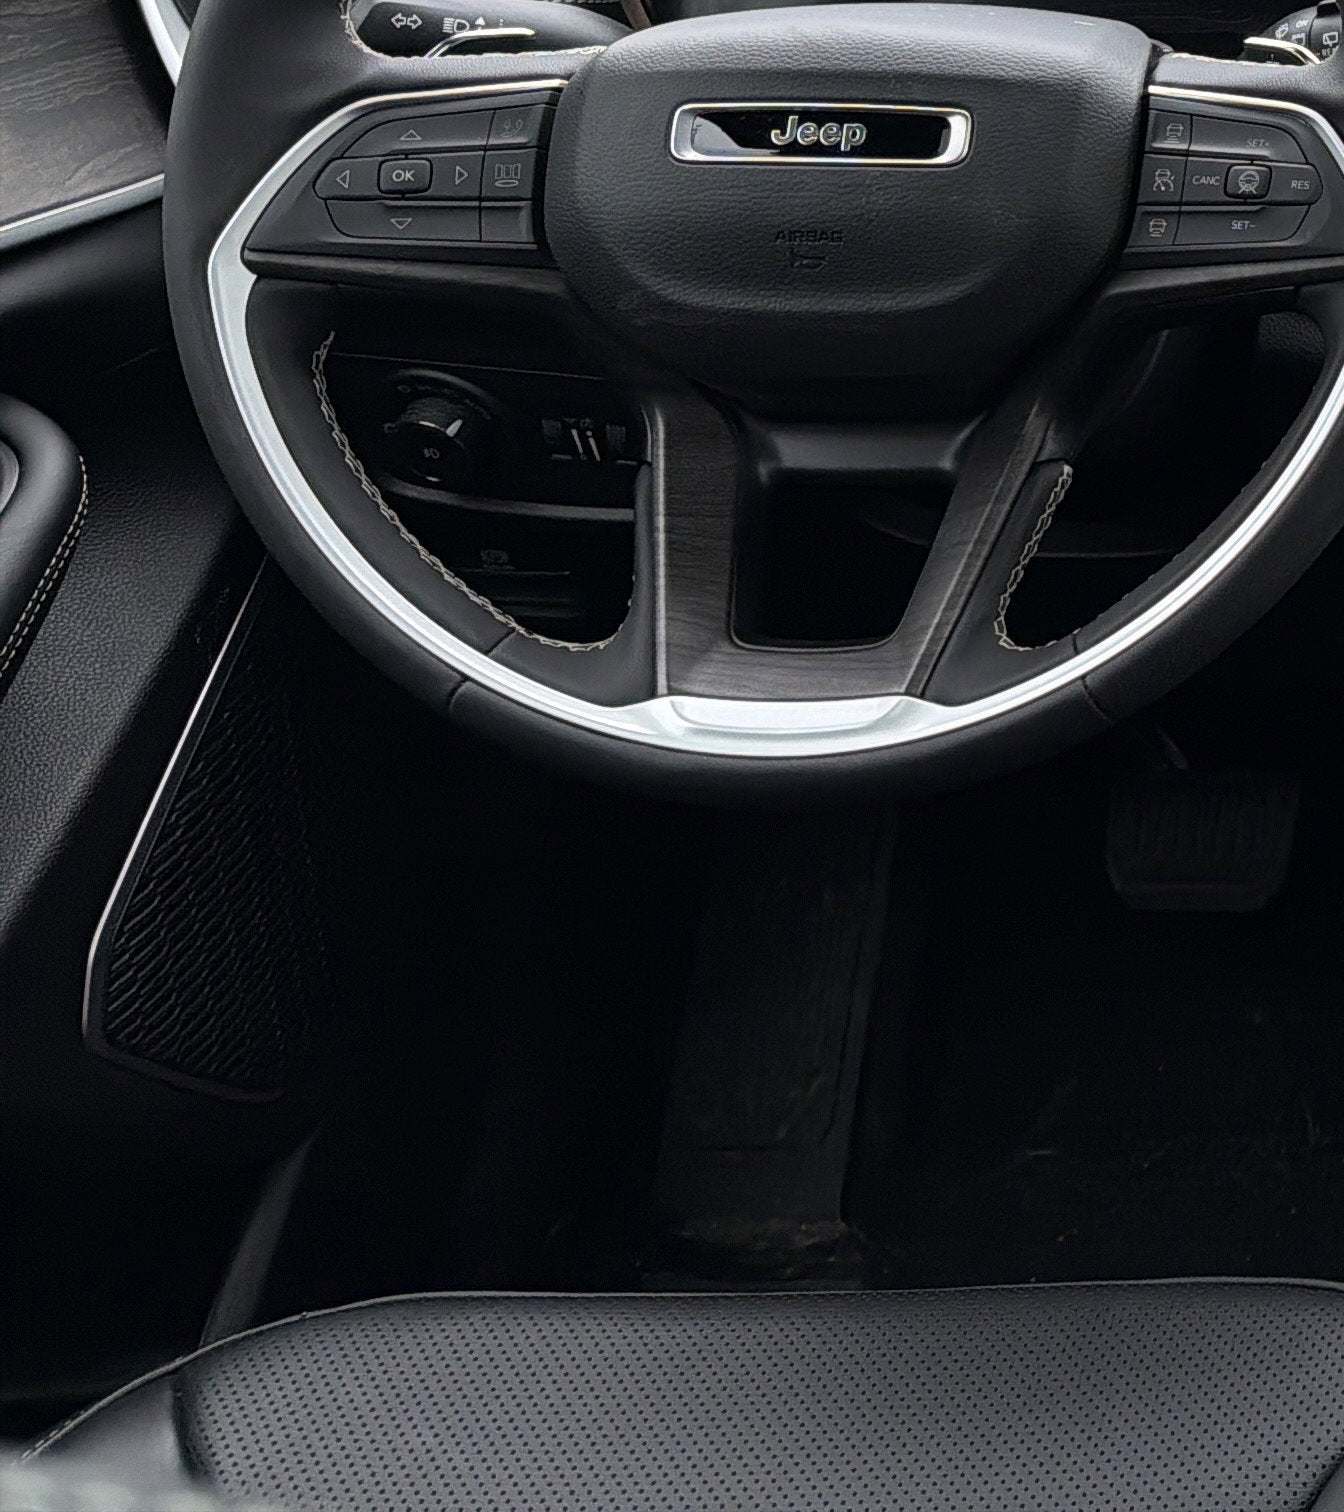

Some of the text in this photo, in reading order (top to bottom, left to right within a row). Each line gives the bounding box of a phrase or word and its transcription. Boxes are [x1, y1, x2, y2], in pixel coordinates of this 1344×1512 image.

[770, 115, 867, 152] Jeep
[392, 169, 415, 182] OK
[1192, 175, 1221, 186] CANC
[1290, 180, 1311, 190] RES
[775, 230, 845, 245] AIRBAG
